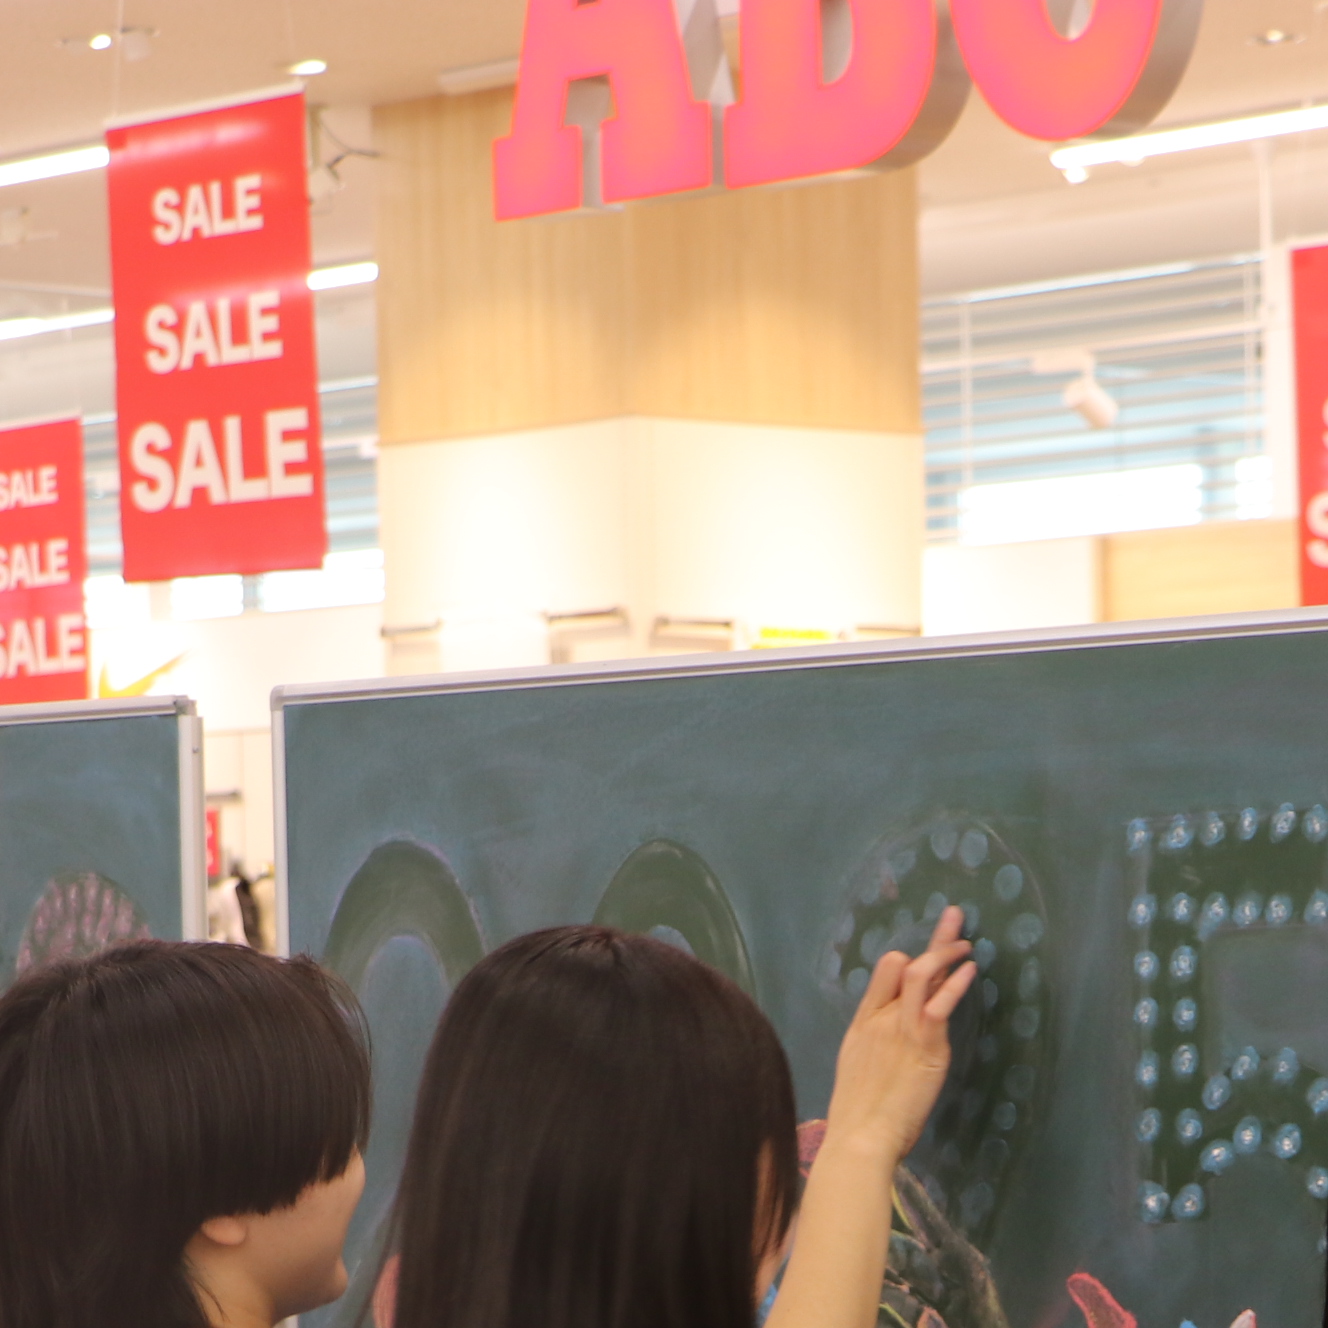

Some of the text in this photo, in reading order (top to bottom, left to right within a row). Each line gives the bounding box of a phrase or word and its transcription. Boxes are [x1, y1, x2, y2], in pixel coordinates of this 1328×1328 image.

[152, 173, 265, 245] SALE
[144, 290, 284, 374] SALE
[129, 407, 314, 513] SALE
